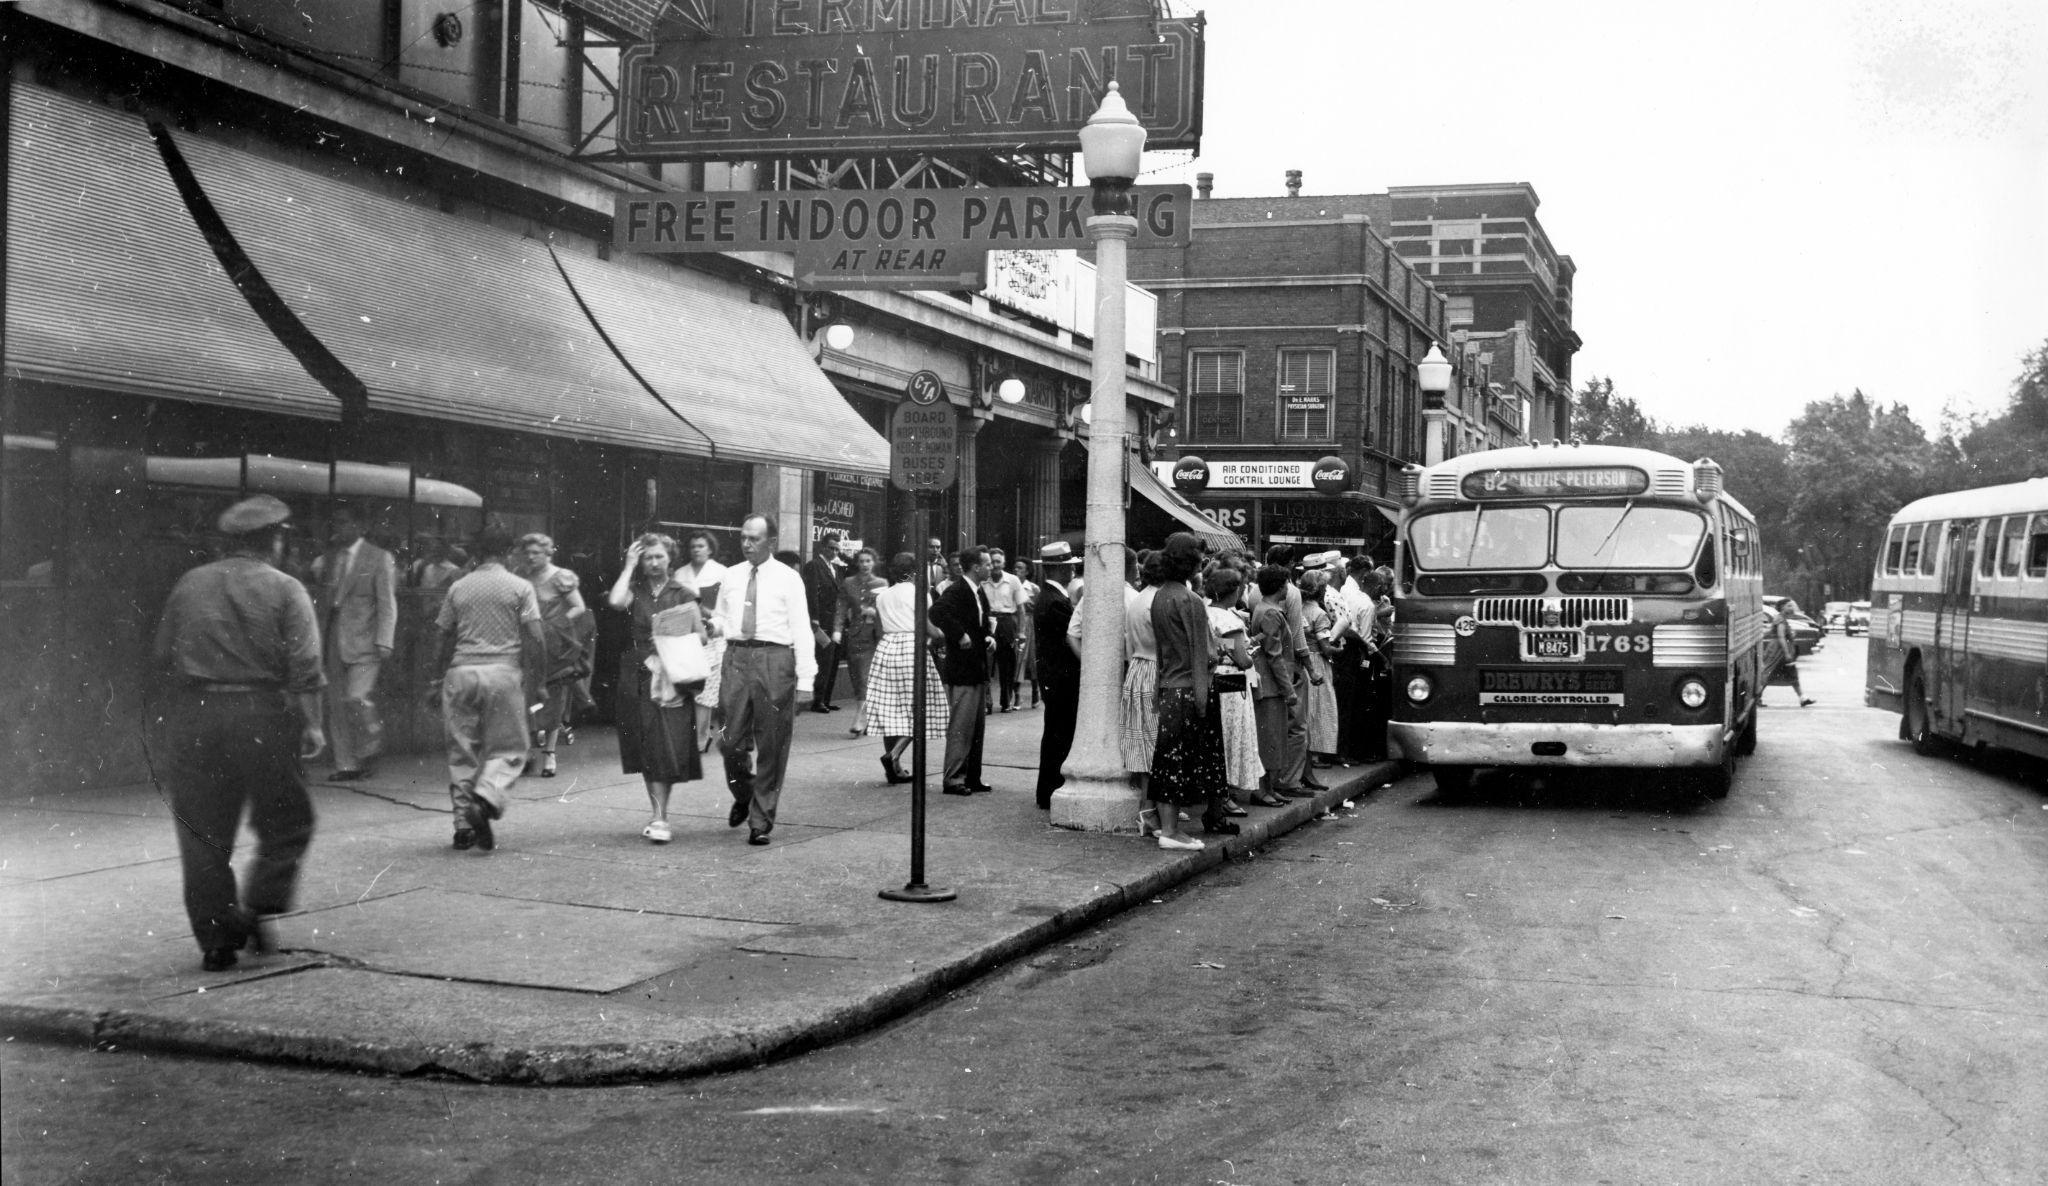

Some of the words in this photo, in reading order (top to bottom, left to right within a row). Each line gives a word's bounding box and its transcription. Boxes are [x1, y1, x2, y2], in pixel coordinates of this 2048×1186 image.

[636, 43, 1176, 136] RESTAURANT
[628, 199, 736, 245] FREE
[759, 197, 937, 243] INDOOR
[962, 192, 1176, 241] PARKG
[832, 250, 871, 271] AT
[875, 248, 947, 271] REAR
[914, 375, 936, 400] CTA
[904, 411, 946, 424] BOARD
[903, 457, 945, 469] BUSES
[1222, 465, 1237, 474] AIR
[1240, 465, 1300, 474] CONDITIONED
[906, 472, 940, 485] HERE
[1223, 475, 1264, 485] COCKTAIL
[1268, 475, 1301, 485] LOUNGE
[1485, 472, 1507, 491] 82
[827, 499, 855, 518] CASHED
[1546, 641, 1569, 654] 8475
[1586, 634, 1650, 653] 1763
[1483, 671, 1581, 691] DREWRYS
[1493, 695, 1610, 704] CALORIE-CONTROLLED
